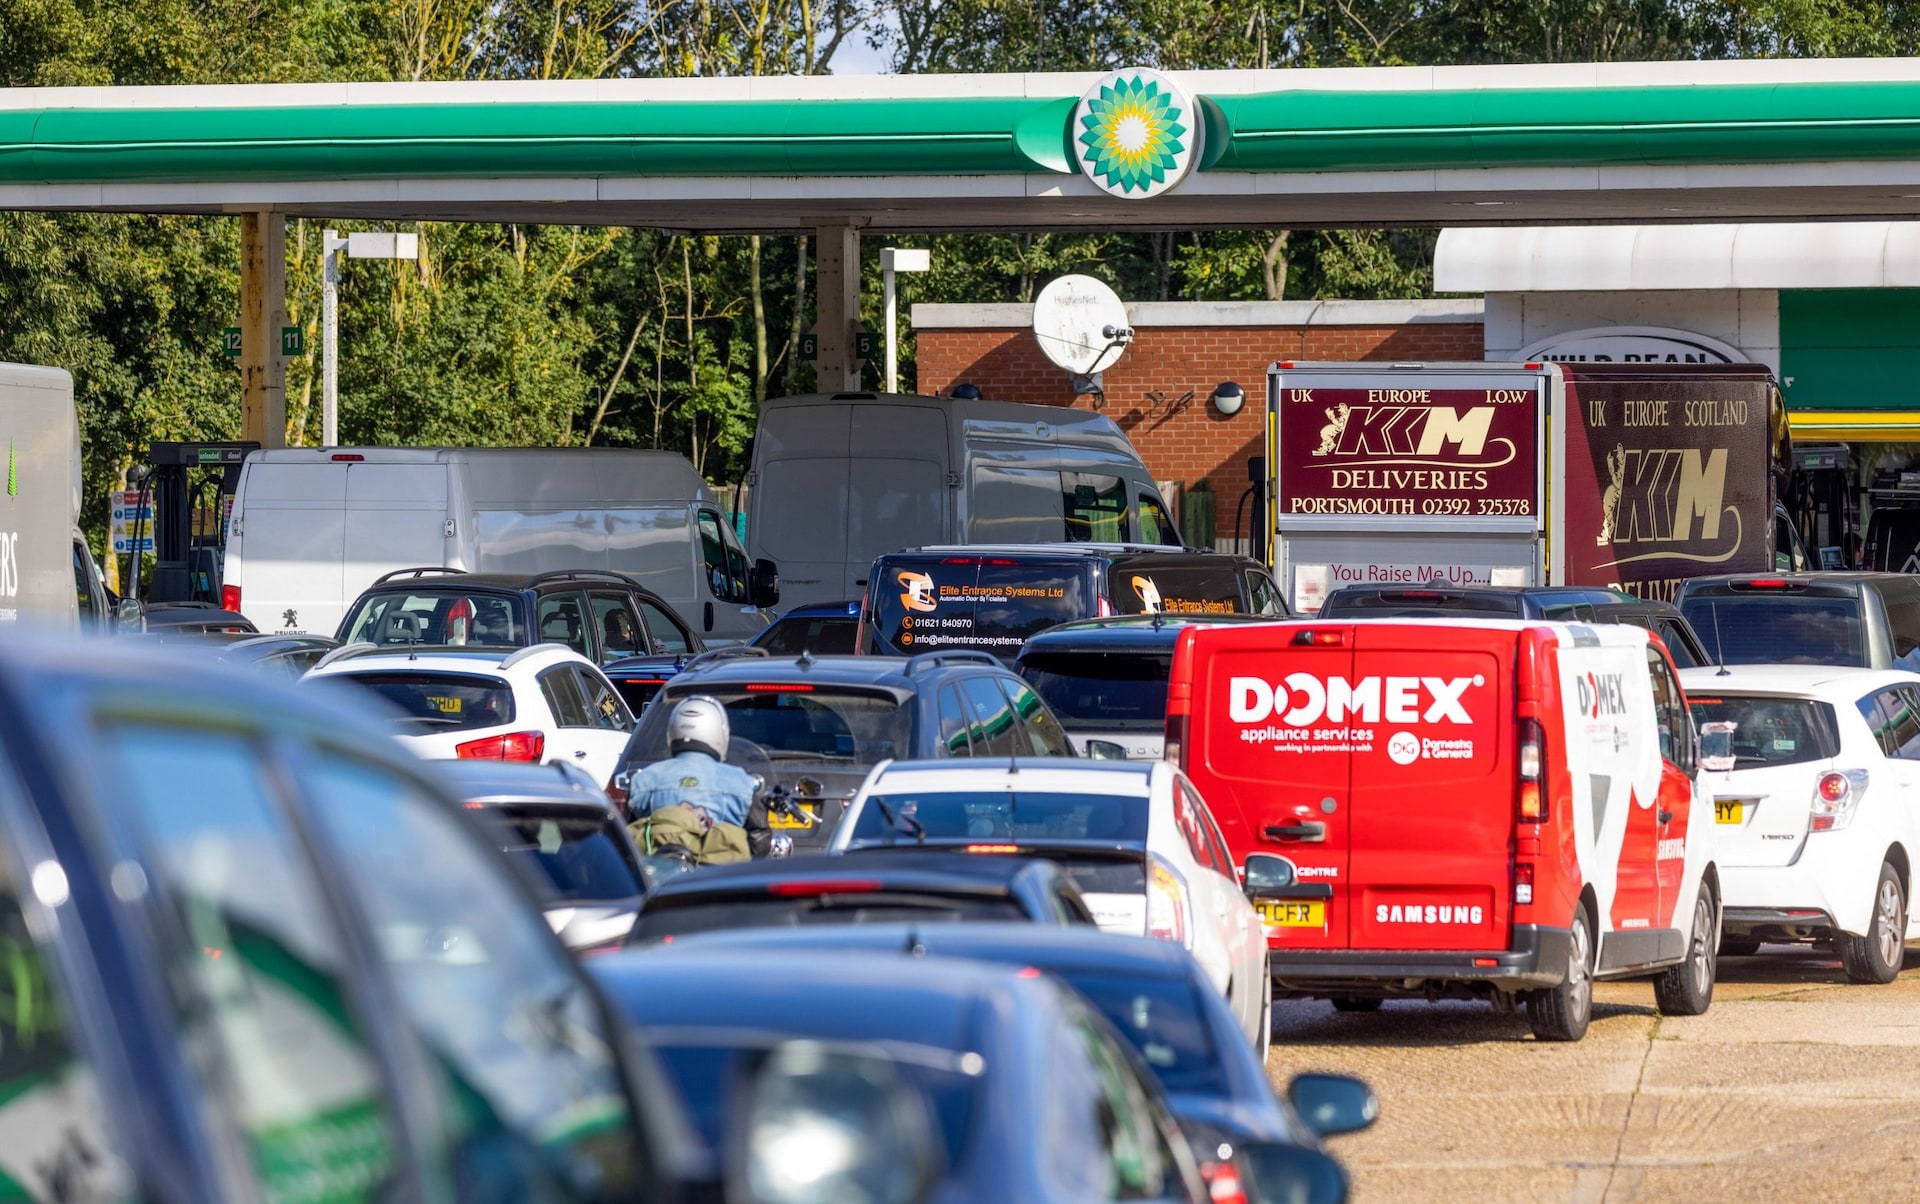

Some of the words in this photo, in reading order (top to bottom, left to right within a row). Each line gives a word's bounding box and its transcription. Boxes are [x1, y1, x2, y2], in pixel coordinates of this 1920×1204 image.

[1054, 296, 1097, 306] HughesNet
[224, 333, 242, 350] 12
[284, 332, 299, 349] 11
[803, 339, 814, 354] 6
[860, 338, 871, 353] 5
[1290, 390, 1314, 403] UK
[1368, 390, 1432, 404] EUROPE
[1485, 391, 1528, 404] I.O.W
[1589, 401, 1607, 427] UK
[1623, 401, 1669, 427] EUROPE
[1684, 400, 1748, 427] SCOTLAND
[1331, 470, 1489, 490] DELIVERIES
[1290, 498, 1415, 515] PORTSMOUTH
[1422, 499, 1470, 515] 02392
[1476, 499, 1531, 516] 325378
[0, 531, 18, 598] RS
[1331, 564, 1363, 582] You
[1368, 565, 1412, 582] Raise
[1417, 565, 1444, 583] Me
[940, 585, 960, 596] Elite
[962, 586, 1003, 597] Entrance
[1005, 586, 1046, 599] Systems
[1047, 588, 1064, 598] Ltd
[1164, 597, 1178, 613] Elite
[1178, 598, 1203, 613] Entrance
[1203, 599, 1225, 614] Systems
[1225, 600, 1234, 614] Ltd
[914, 618, 939, 628] 01621
[942, 619, 972, 629] 840970
[1576, 671, 1627, 720] DOMEX
[1240, 726, 1310, 744] appliance
[1313, 726, 1374, 741] services
[1422, 737, 1473, 750] Domestic
[1274, 742, 1303, 754] working
[1304, 743, 1311, 752] in
[1311, 742, 1355, 753] partnership
[1355, 743, 1373, 752] with
[1432, 749, 1473, 759] General
[1298, 867, 1338, 877] CENTRE
[1273, 904, 1311, 922] CFR
[1375, 904, 1483, 924] SAMSUNG
